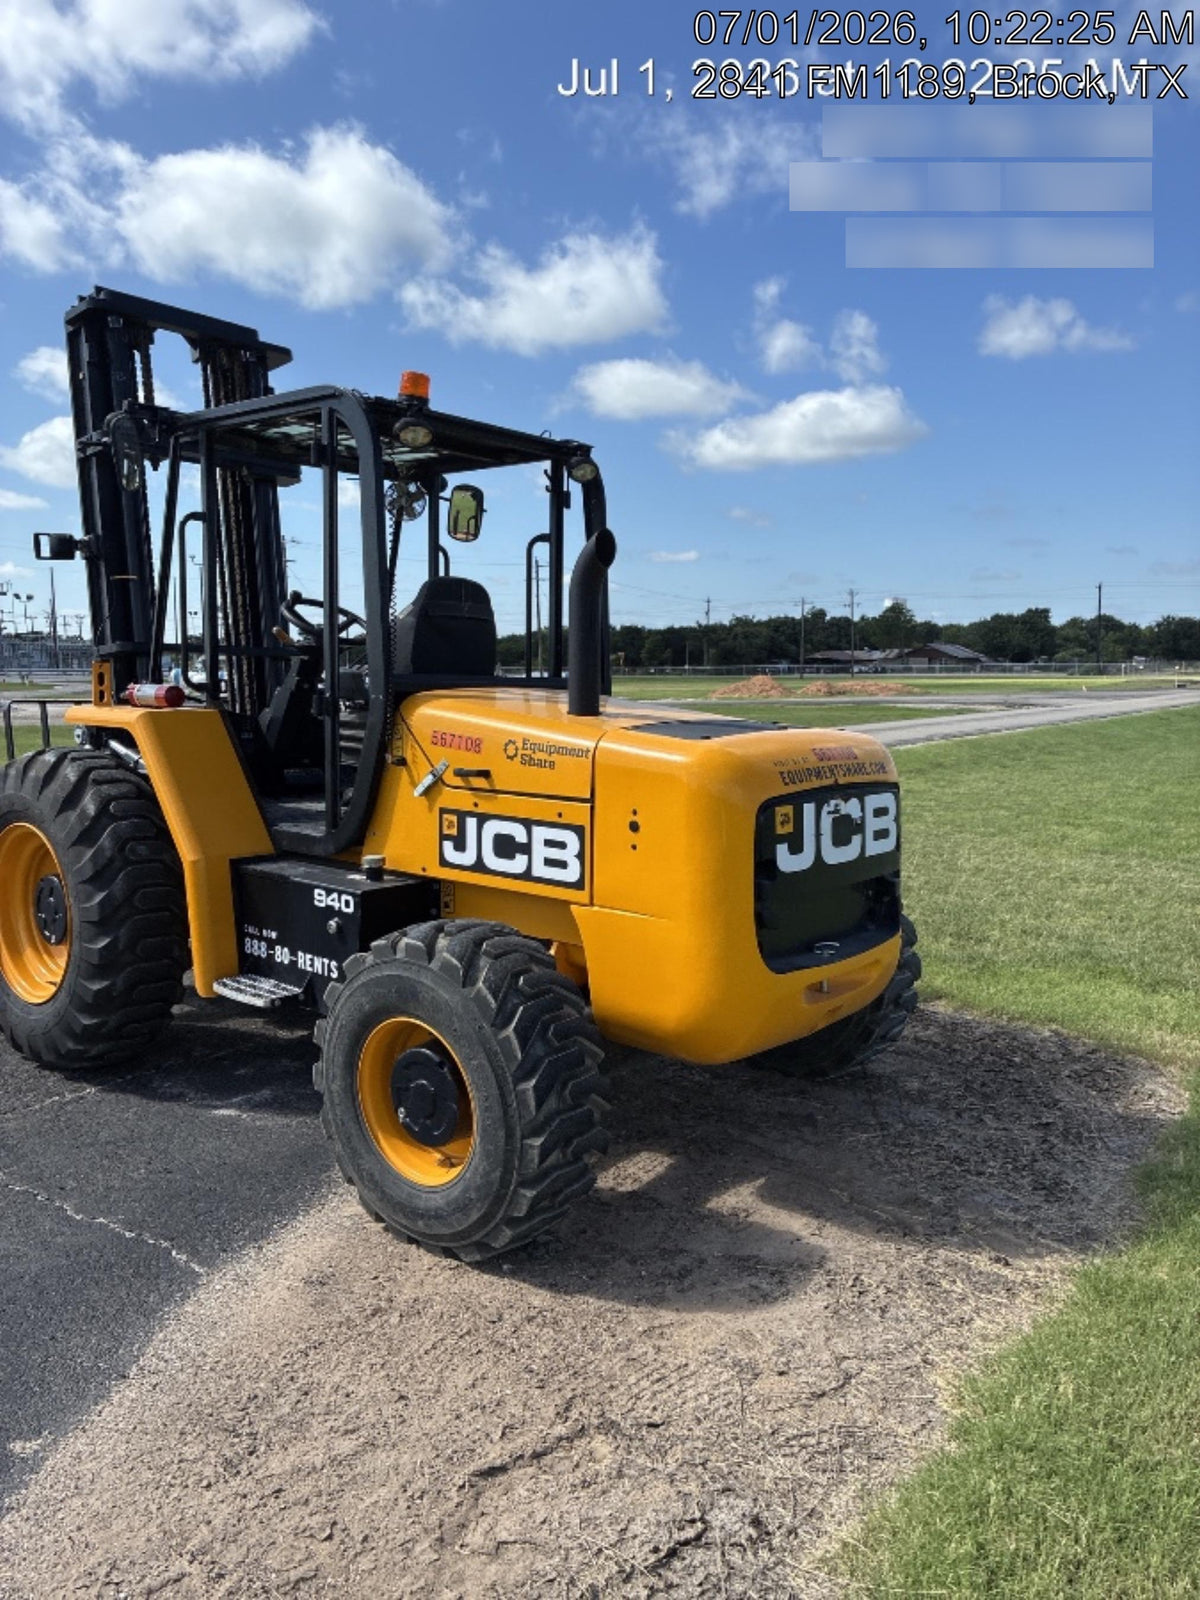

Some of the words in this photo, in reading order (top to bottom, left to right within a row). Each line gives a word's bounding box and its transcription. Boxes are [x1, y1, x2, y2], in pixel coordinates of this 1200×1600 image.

[519, 752, 556, 771] Share
[521, 738, 590, 759] Equipment
[776, 793, 897, 872] JCB
[443, 817, 581, 883] JCB
[314, 889, 354, 913] 940
[244, 937, 339, 979] 888-80-RENTS
